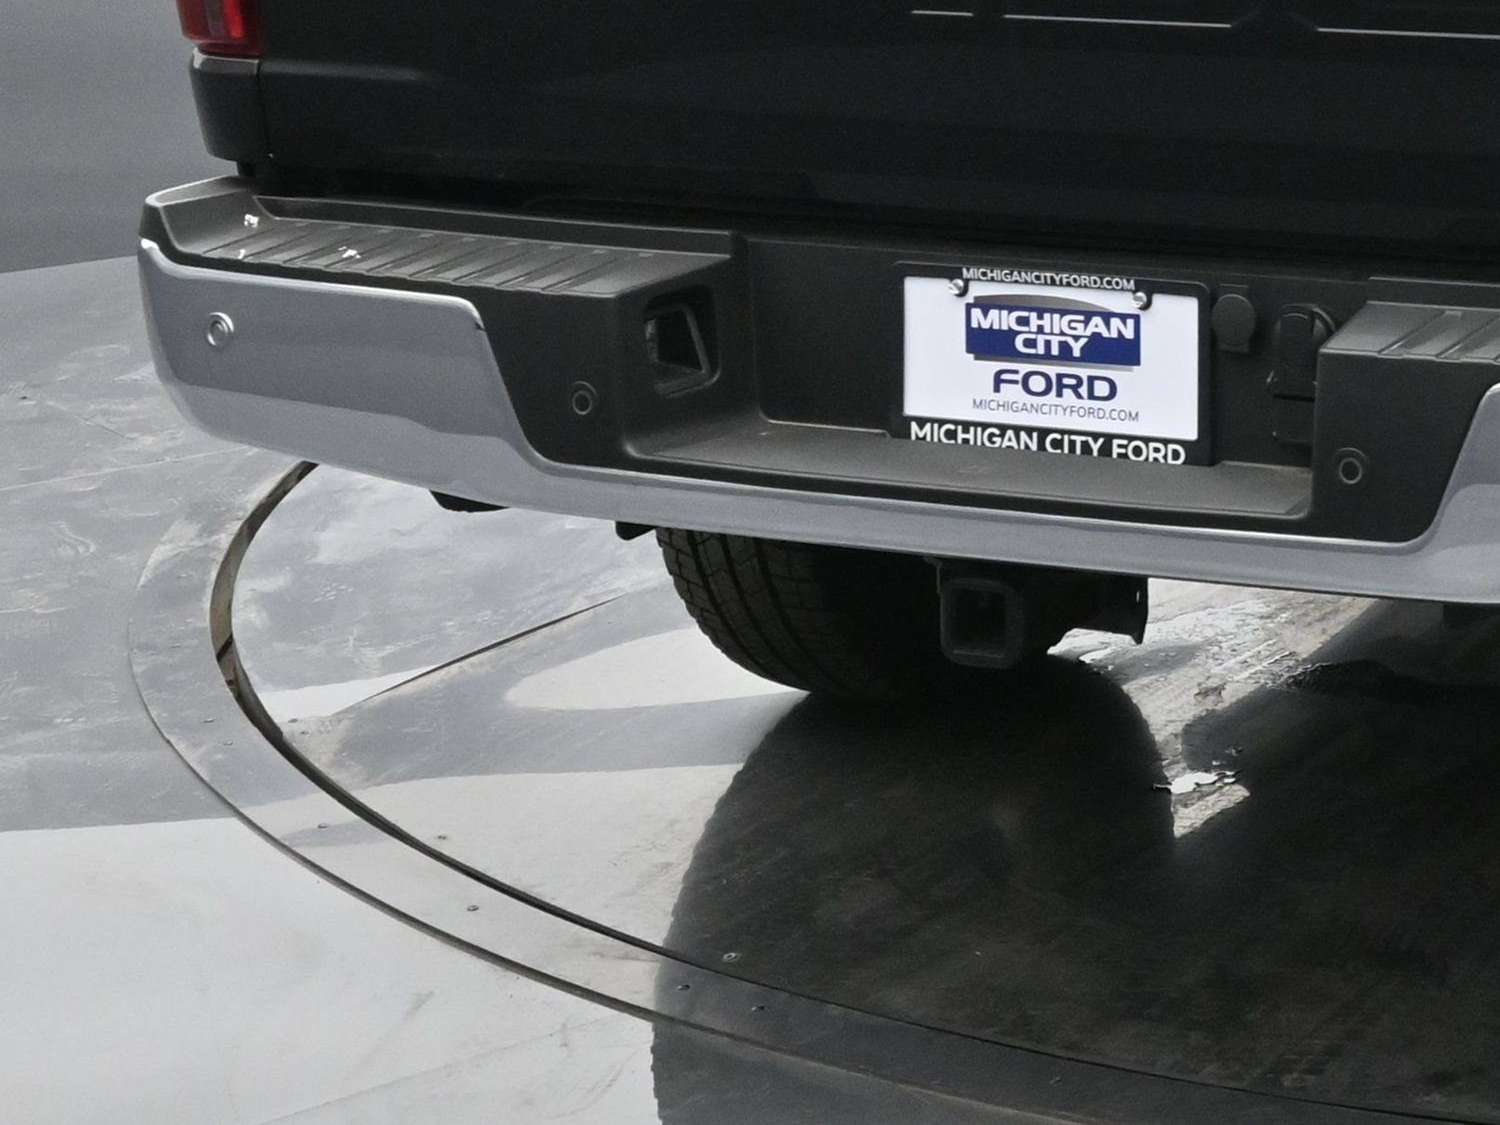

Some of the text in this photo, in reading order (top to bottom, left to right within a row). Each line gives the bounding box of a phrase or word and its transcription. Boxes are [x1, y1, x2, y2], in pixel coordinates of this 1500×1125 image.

[962, 267, 1135, 291] MICHIGANCITYFORD.COM
[970, 307, 1134, 339] MICHIGAN
[1014, 334, 1089, 357] CITY
[993, 369, 1117, 402] FORD
[972, 399, 1139, 423] MICHIGANCITYFORD.COM
[910, 421, 1186, 466] MICHIGAN CITY FORD
